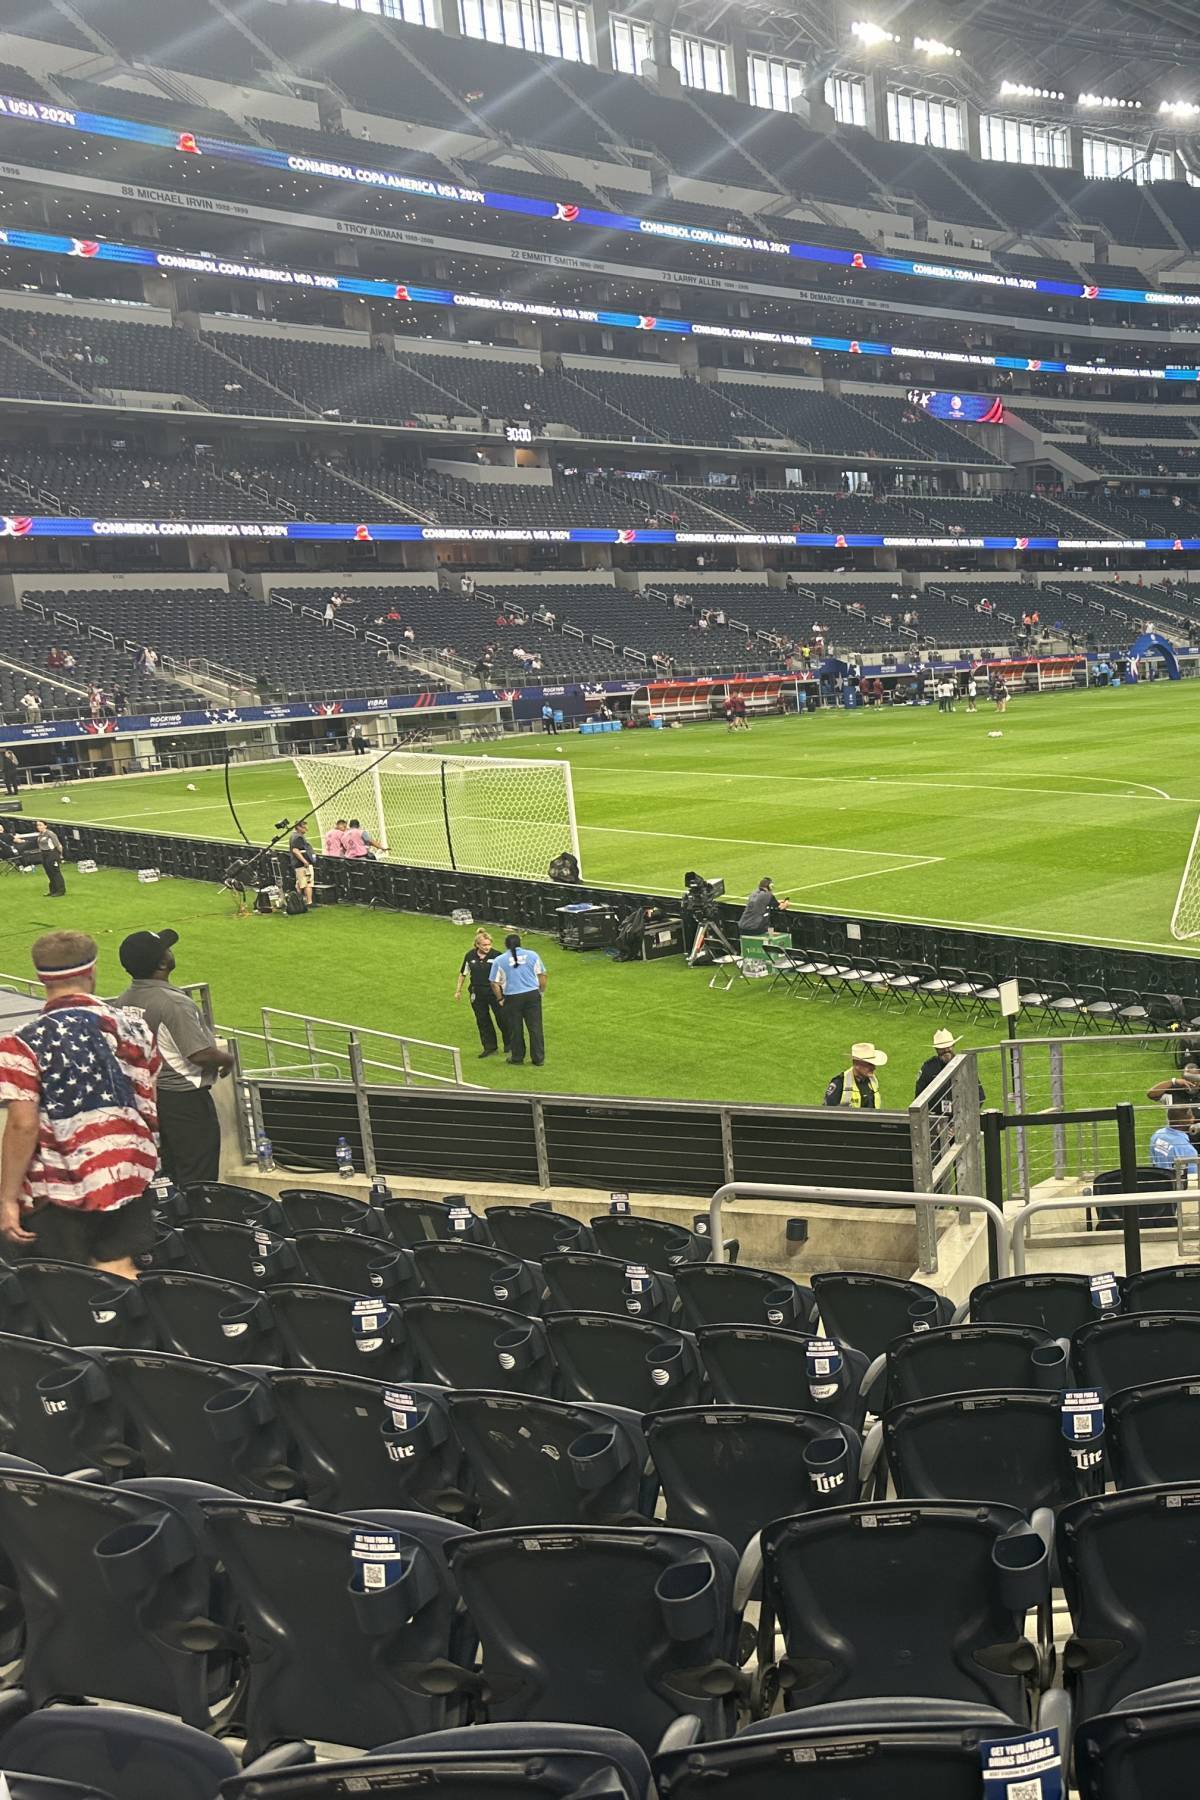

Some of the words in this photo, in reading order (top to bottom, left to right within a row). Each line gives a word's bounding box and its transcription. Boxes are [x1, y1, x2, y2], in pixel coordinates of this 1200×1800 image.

[9, 100, 38, 117] USA
[39, 106, 75, 125] 2024
[288, 157, 355, 179] CONMEBOL
[356, 169, 384, 184] COPA
[384, 175, 436, 194] AMERICA
[437, 184, 458, 199] USA
[459, 188, 484, 203] 2024
[121, 186, 134, 197] 88
[137, 188, 184, 205] MICHAEL
[186, 197, 213, 210] IRVIN
[336, 223, 342, 231] 8
[344, 223, 368, 236] TROY
[369, 227, 403, 241] AIKMAN
[640, 221, 691, 238] CONMEBOL
[691, 230, 714, 242] COPA
[714, 234, 752, 248] AMERICA
[754, 239, 769, 251] USA
[511, 250, 520, 258] 22
[521, 252, 552, 265] EMMITT
[554, 256, 578, 267] SMITH
[157, 255, 218, 272] CONMEBOL
[218, 263, 247, 276] COPA
[247, 267, 293, 282] AMERICA
[294, 273, 314, 285] USA
[314, 276, 338, 288] 2024
[662, 272, 672, 281] 73
[673, 273, 697, 284] LARRY
[698, 276, 721, 287] ALLEN
[953, 270, 972, 280] COPA
[972, 273, 1005, 285] AMERICA
[1006, 277, 1019, 287] USA
[502, 301, 524, 312] COPA
[524, 304, 562, 316] AMERICA
[562, 309, 578, 319] USA
[846, 297, 864, 306] WARE
[506, 427, 531, 442] 30:00
[93, 522, 160, 534] CONMEBOL
[160, 523, 190, 534] COPA
[190, 524, 240, 535] AMERICA
[241, 525, 262, 536] USA
[262, 525, 288, 536] 2024
[472, 530, 494, 539] COPA
[494, 530, 533, 539] AMERICA
[533, 531, 548, 540] USA
[367, 698, 388, 707] VIBRA
[150, 714, 182, 723] ROCKING
[1070, 1449, 1103, 1470] Lite
[810, 1472, 844, 1493] Lite
[990, 1746, 1004, 1756] GET
[1005, 1743, 1024, 1755] YOUR
[1025, 1738, 1044, 1751] FOOD
